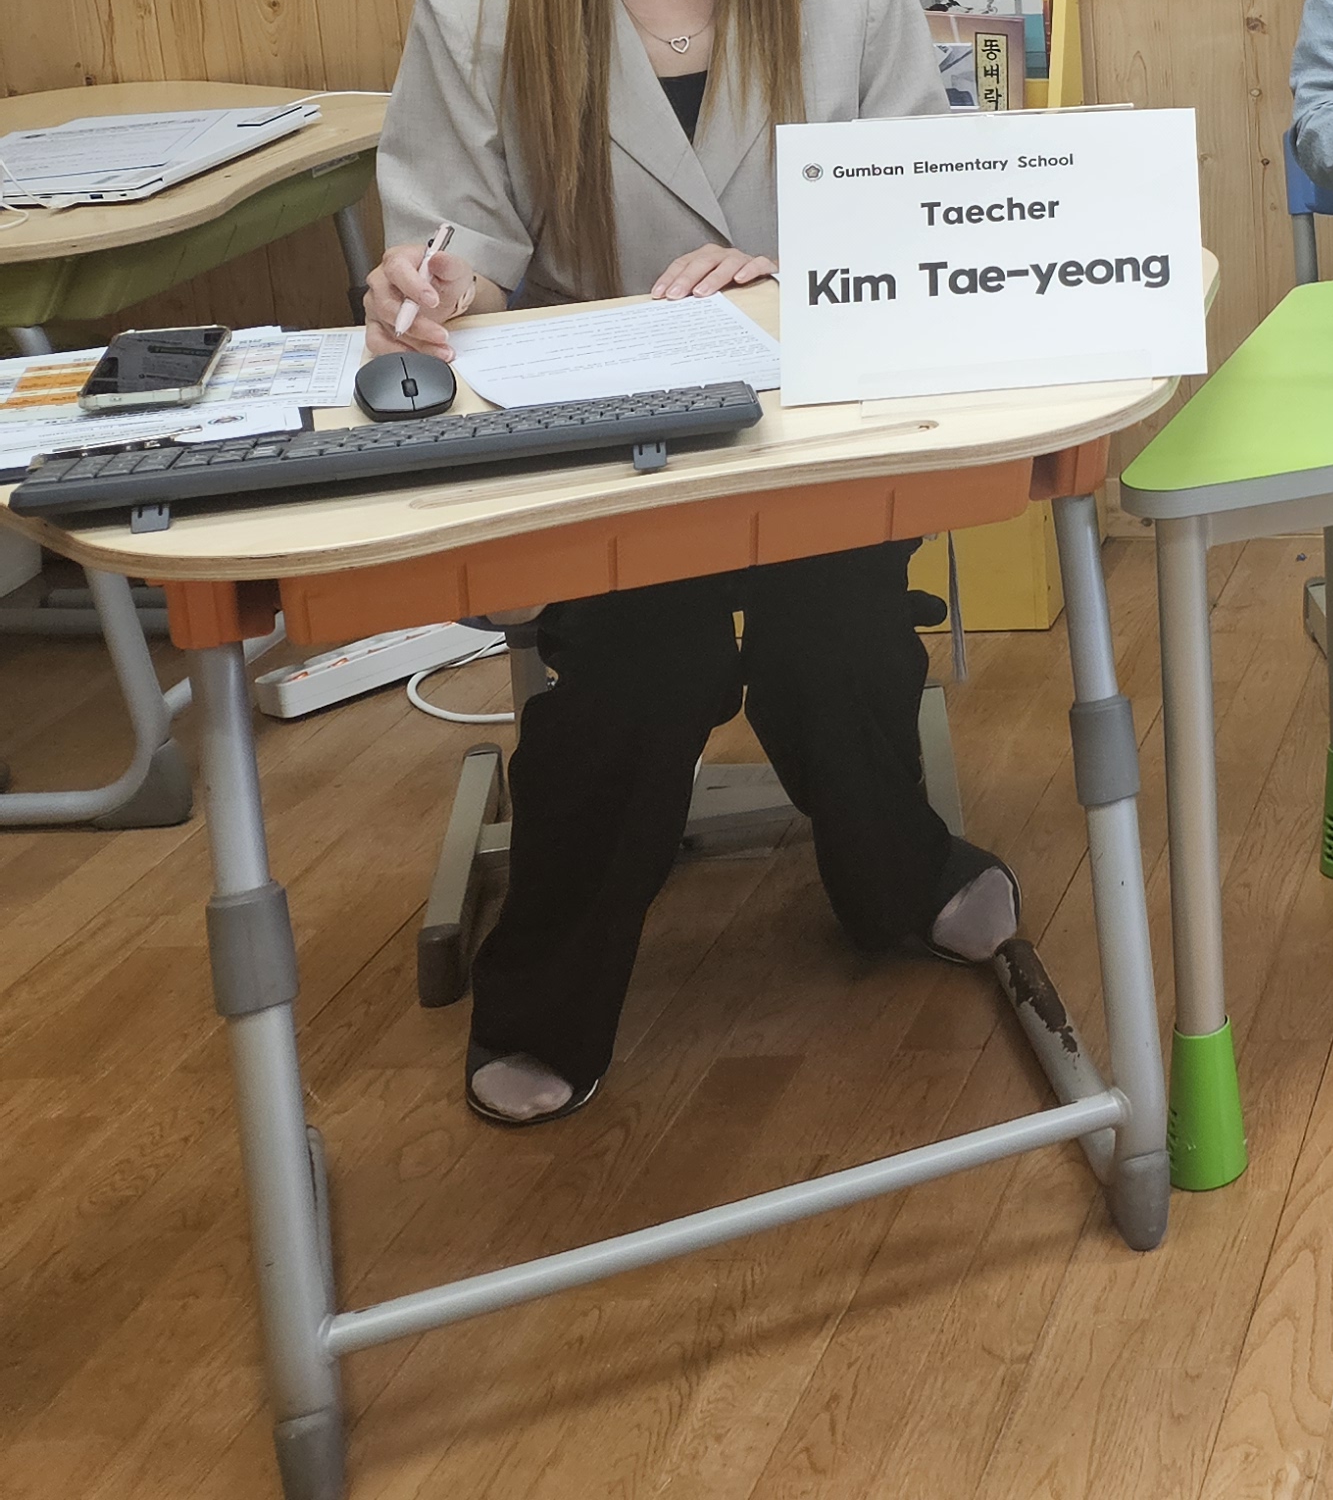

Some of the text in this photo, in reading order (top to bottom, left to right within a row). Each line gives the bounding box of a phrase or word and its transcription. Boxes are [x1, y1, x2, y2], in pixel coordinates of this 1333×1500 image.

[981, 39, 1003, 111] 똥벼락
[833, 154, 1074, 179] Gumban Elementary School
[920, 197, 1059, 226] Taecher
[808, 254, 1170, 306] Kim Tae-yeong
